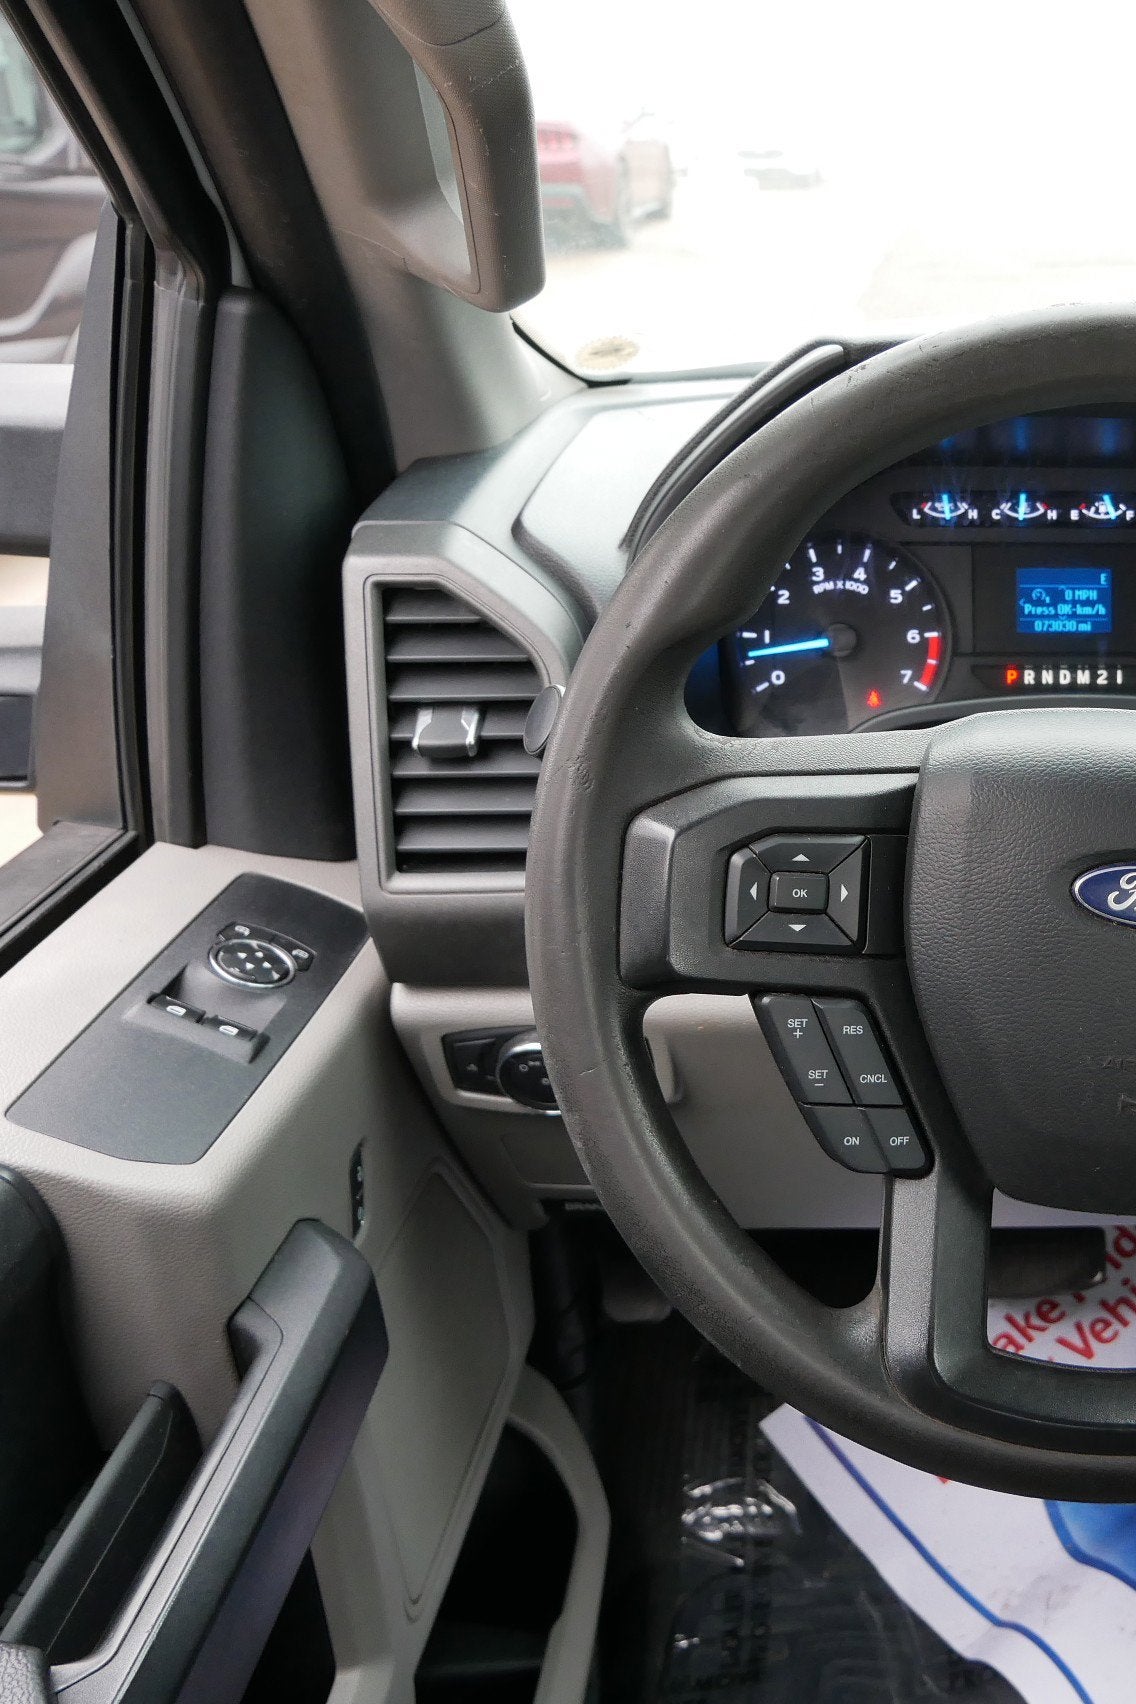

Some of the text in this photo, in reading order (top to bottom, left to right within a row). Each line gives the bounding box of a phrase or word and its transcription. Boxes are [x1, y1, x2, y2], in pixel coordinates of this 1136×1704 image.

[912, 509, 921, 520] L
[968, 509, 978, 521] H
[991, 509, 1001, 521] C
[1047, 509, 1057, 521] H
[1070, 509, 1079, 521] E
[1126, 510, 1135, 521] F
[811, 566, 825, 582] 3
[853, 566, 867, 582] 4
[1100, 573, 1108, 585] E
[812, 580, 869, 595] RPM X 1000
[777, 589, 790, 605] 2
[889, 589, 903, 604] 5
[1064, 589, 1098, 601] 0 MPH
[1024, 603, 1055, 615] Press
[1034, 620, 1092, 632] 073030 mi
[764, 629, 770, 645] 1
[906, 629, 921, 644] 6
[771, 669, 786, 686] 0
[900, 669, 913, 685] 7
[1006, 669, 1018, 685] P
[1023, 669, 1035, 685] R
[1041, 669, 1054, 685] N
[1059, 669, 1071, 685] D
[1076, 669, 1091, 685] M
[1096, 669, 1108, 685] 2
[792, 887, 808, 899] OK
[787, 1018, 808, 1028] SET
[843, 1025, 863, 1035] RES
[808, 1070, 828, 1079] SET
[859, 1074, 888, 1084] CNCL
[844, 1136, 860, 1146] ON
[889, 1136, 910, 1146] OFF
[992, 1297, 1068, 1354] ake
